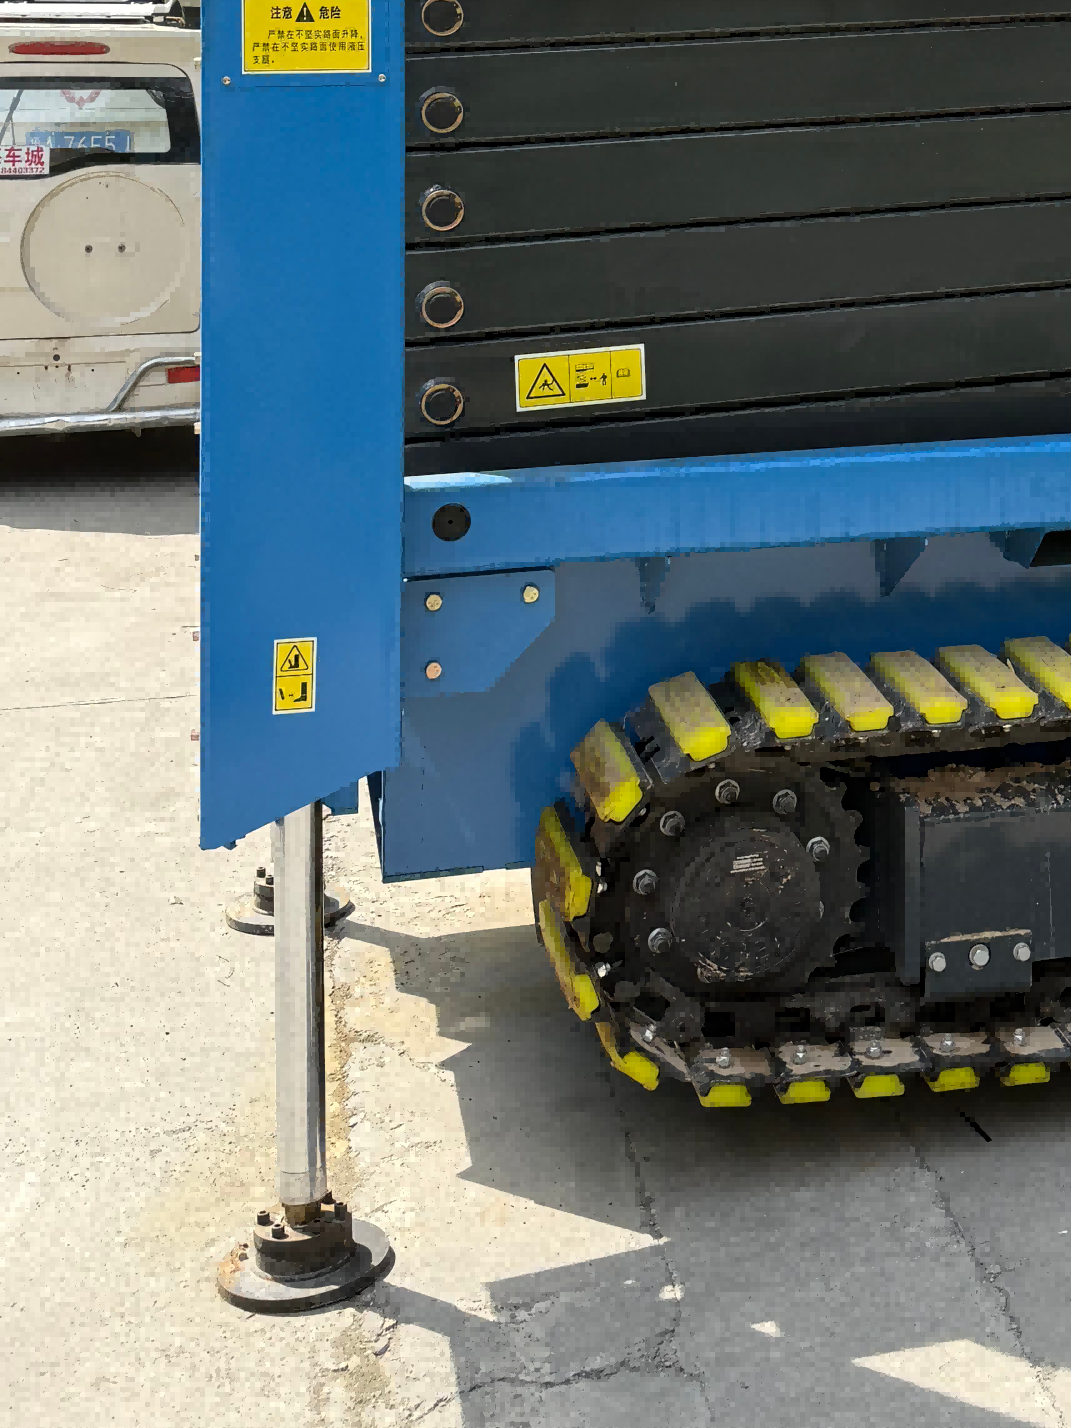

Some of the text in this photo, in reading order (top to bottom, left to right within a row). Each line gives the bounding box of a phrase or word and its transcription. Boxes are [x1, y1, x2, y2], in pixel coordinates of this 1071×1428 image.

[270, 6, 341, 19] 注意 危险
[0, 146, 45, 167] 车城
